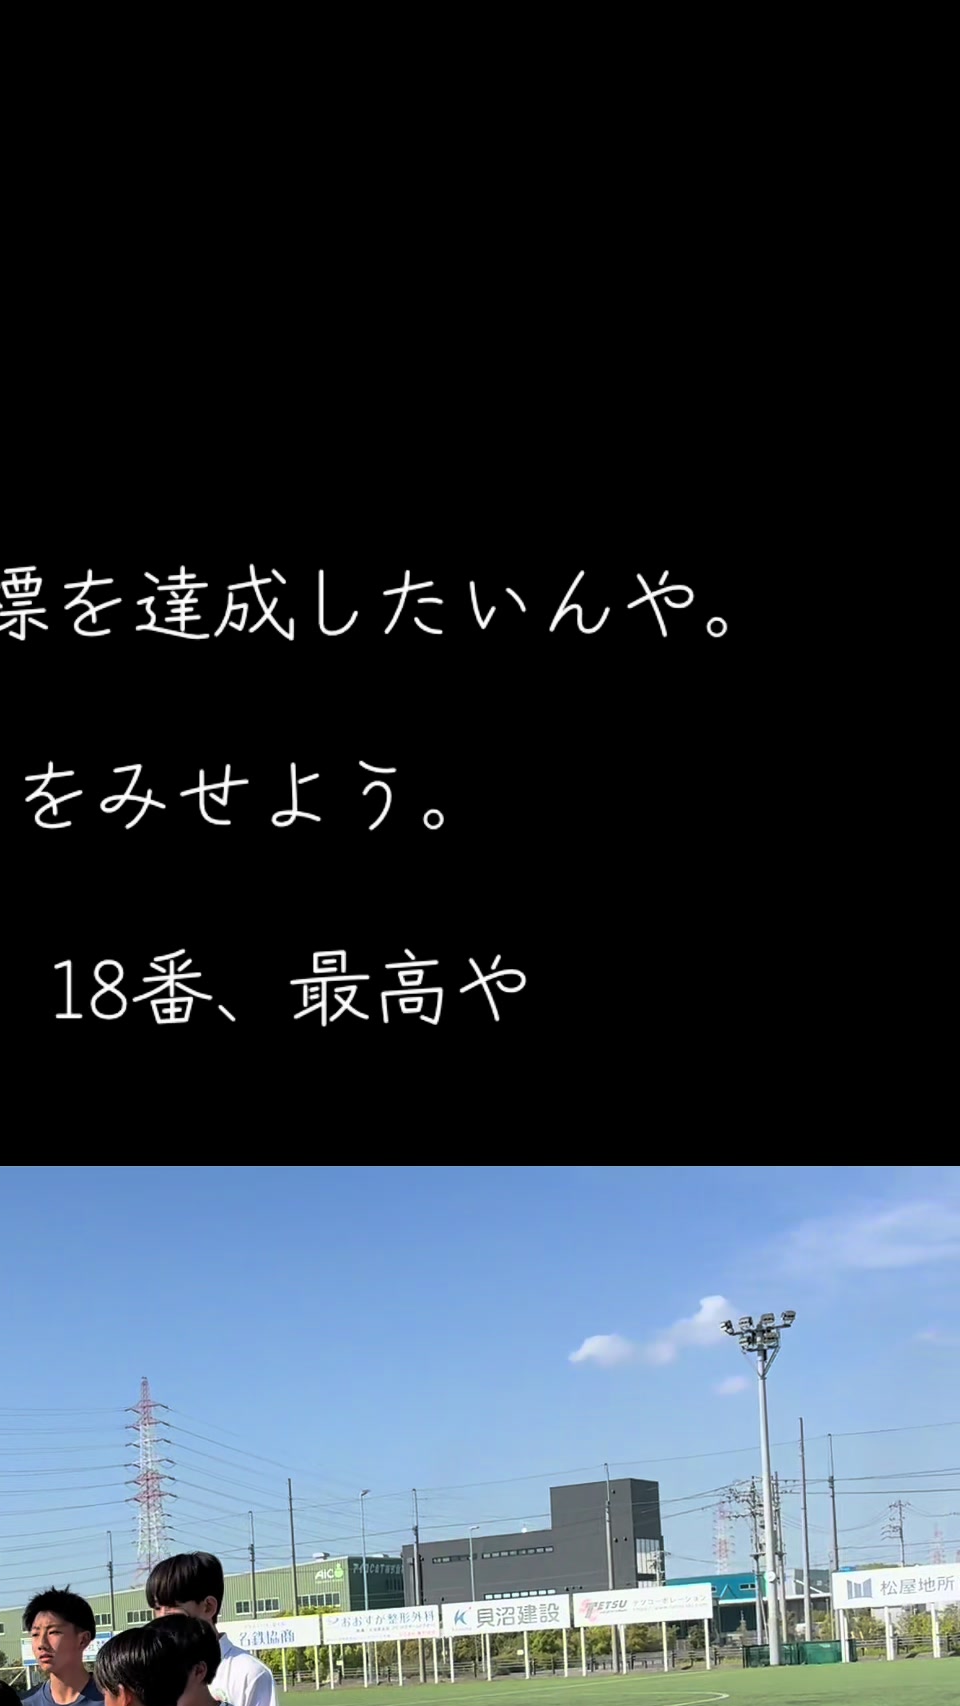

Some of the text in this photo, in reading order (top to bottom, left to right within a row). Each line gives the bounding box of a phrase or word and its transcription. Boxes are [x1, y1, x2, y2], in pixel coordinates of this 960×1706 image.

[880, 1576, 955, 1596] 松屋地所
[477, 1603, 560, 1628] 貝沼建設
[240, 1629, 295, 1647] 名鉄協商
